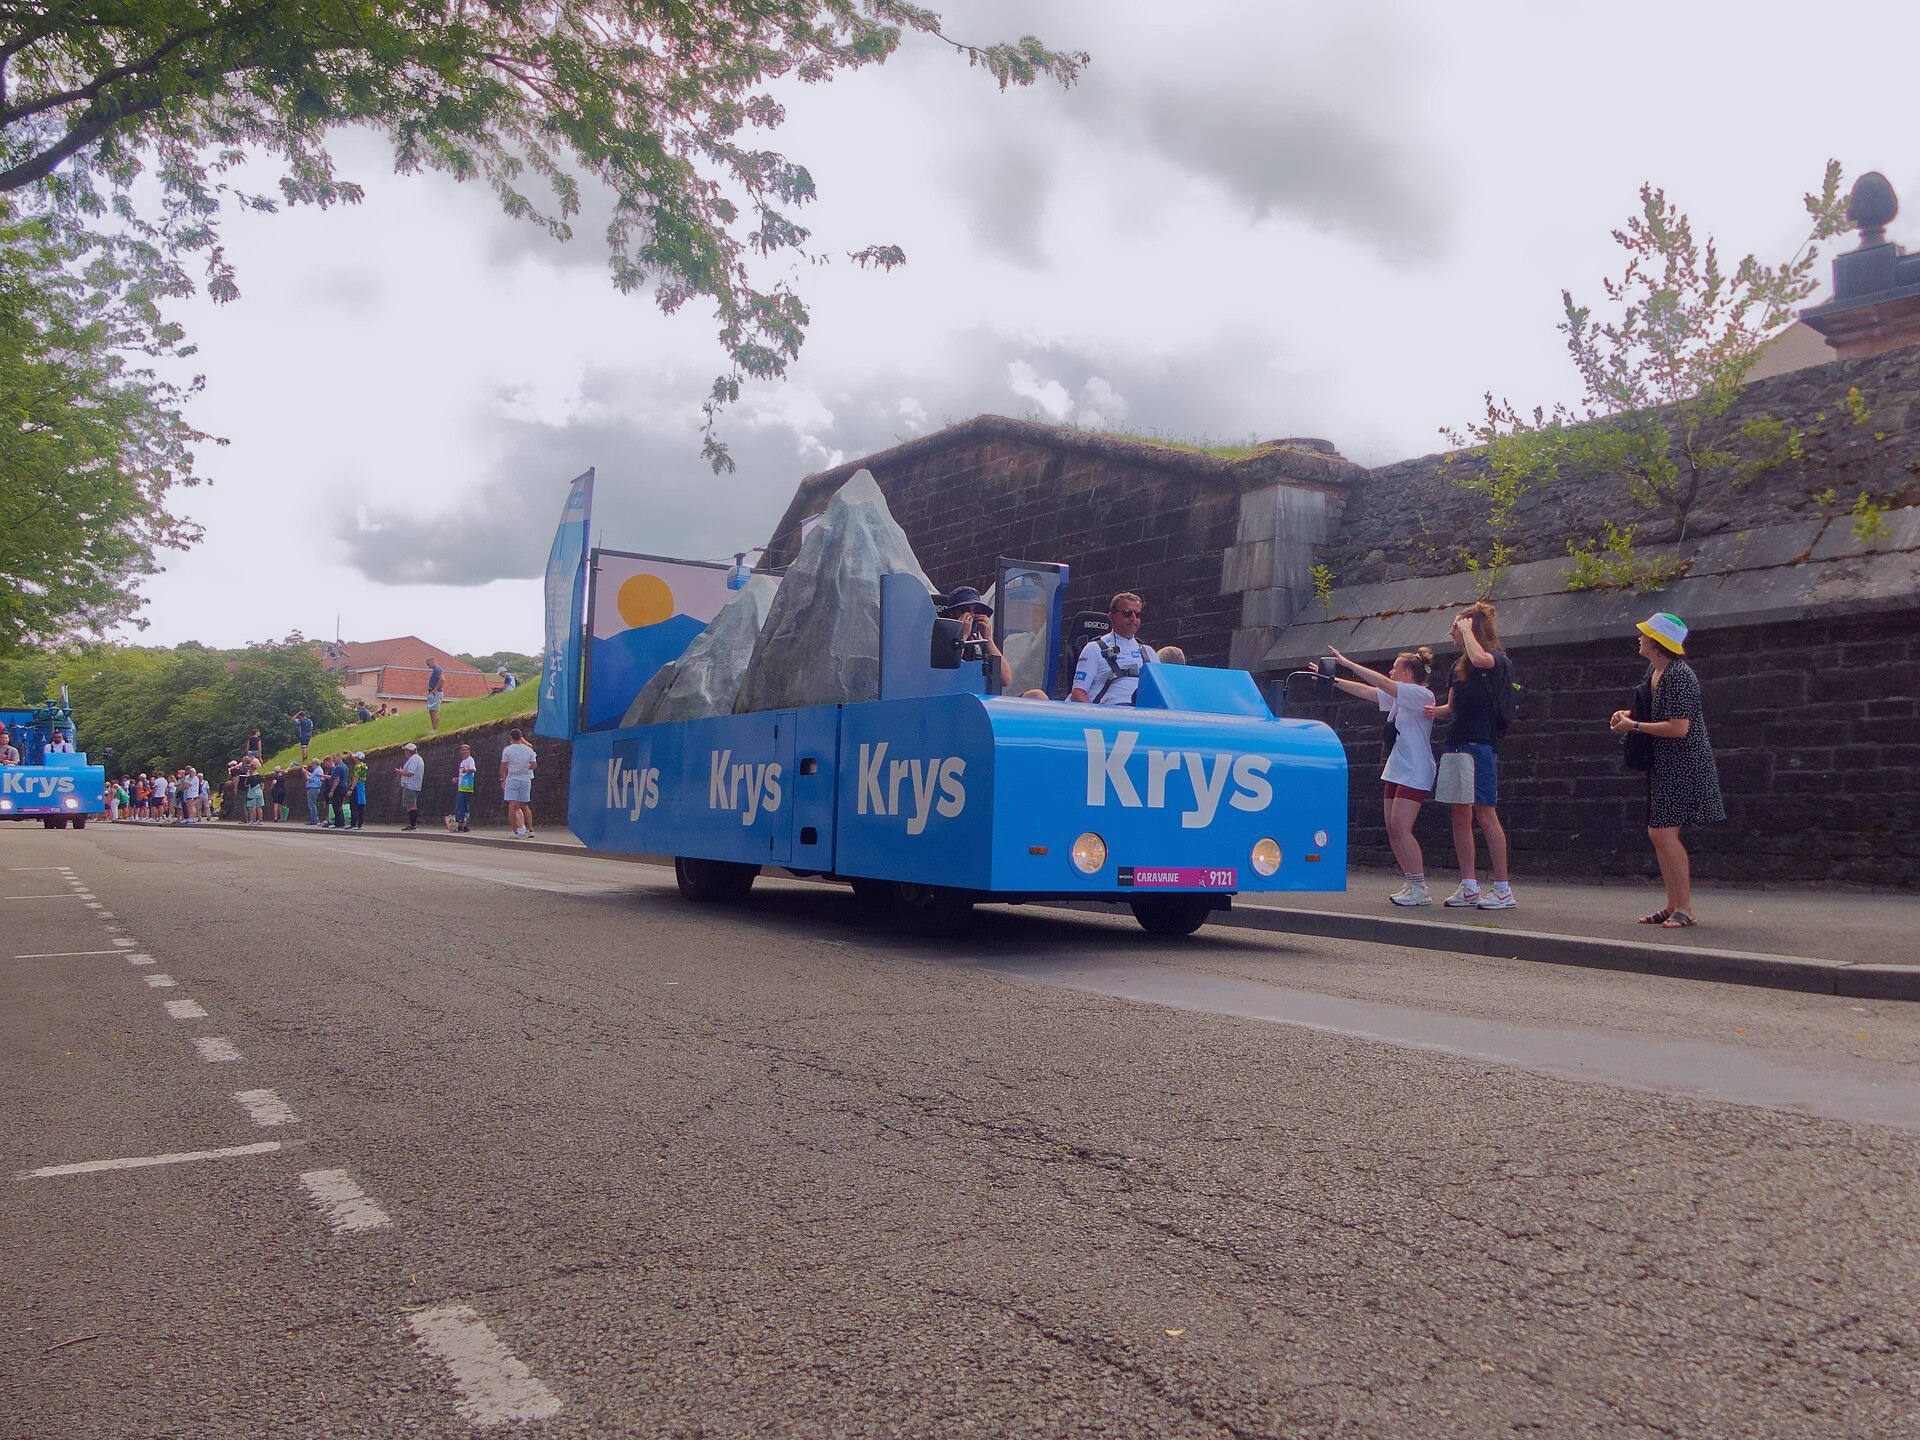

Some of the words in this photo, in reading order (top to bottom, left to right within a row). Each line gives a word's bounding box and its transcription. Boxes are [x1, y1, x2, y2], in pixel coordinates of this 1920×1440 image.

[546, 559, 563, 700] PARAIRE
[1083, 620, 1110, 630] sparco
[3, 772, 75, 798] Krys
[606, 757, 660, 822] Krys
[709, 749, 782, 826] Krys
[857, 742, 967, 835] Krys
[1083, 728, 1273, 829] Krys
[1136, 872, 1179, 883] CARAVANE
[1209, 871, 1232, 886] 9121
